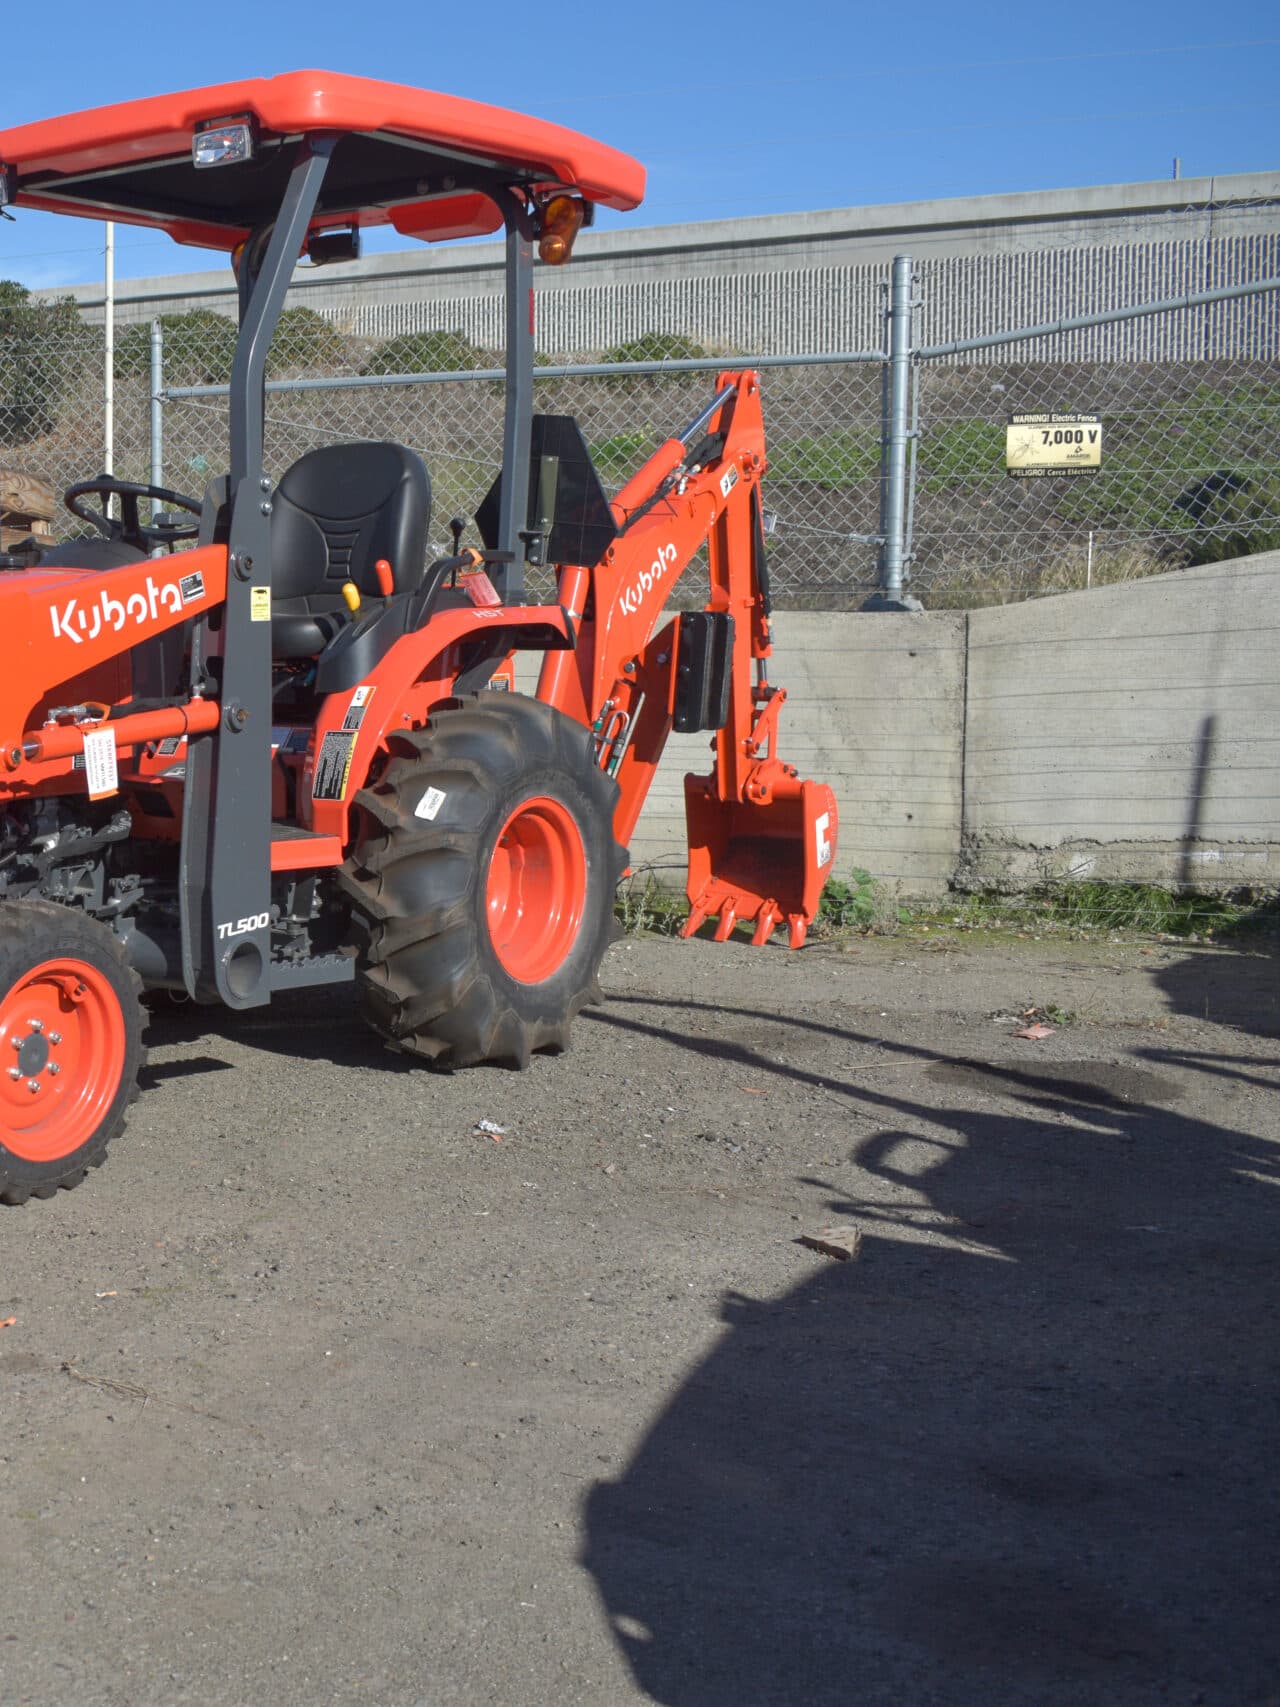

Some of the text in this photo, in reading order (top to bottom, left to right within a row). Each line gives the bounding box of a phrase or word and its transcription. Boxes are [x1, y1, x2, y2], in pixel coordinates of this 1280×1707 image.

[1013, 413, 1097, 423] WARNING! Electric Fence
[1041, 430, 1098, 447] 7,000 V
[1047, 469, 1066, 477] Cerca
[1067, 468, 1097, 476] Eléctrica
[619, 543, 677, 616] Kubota
[49, 576, 183, 643] Kubota
[472, 608, 505, 618] HST
[217, 912, 270, 939] TL500
